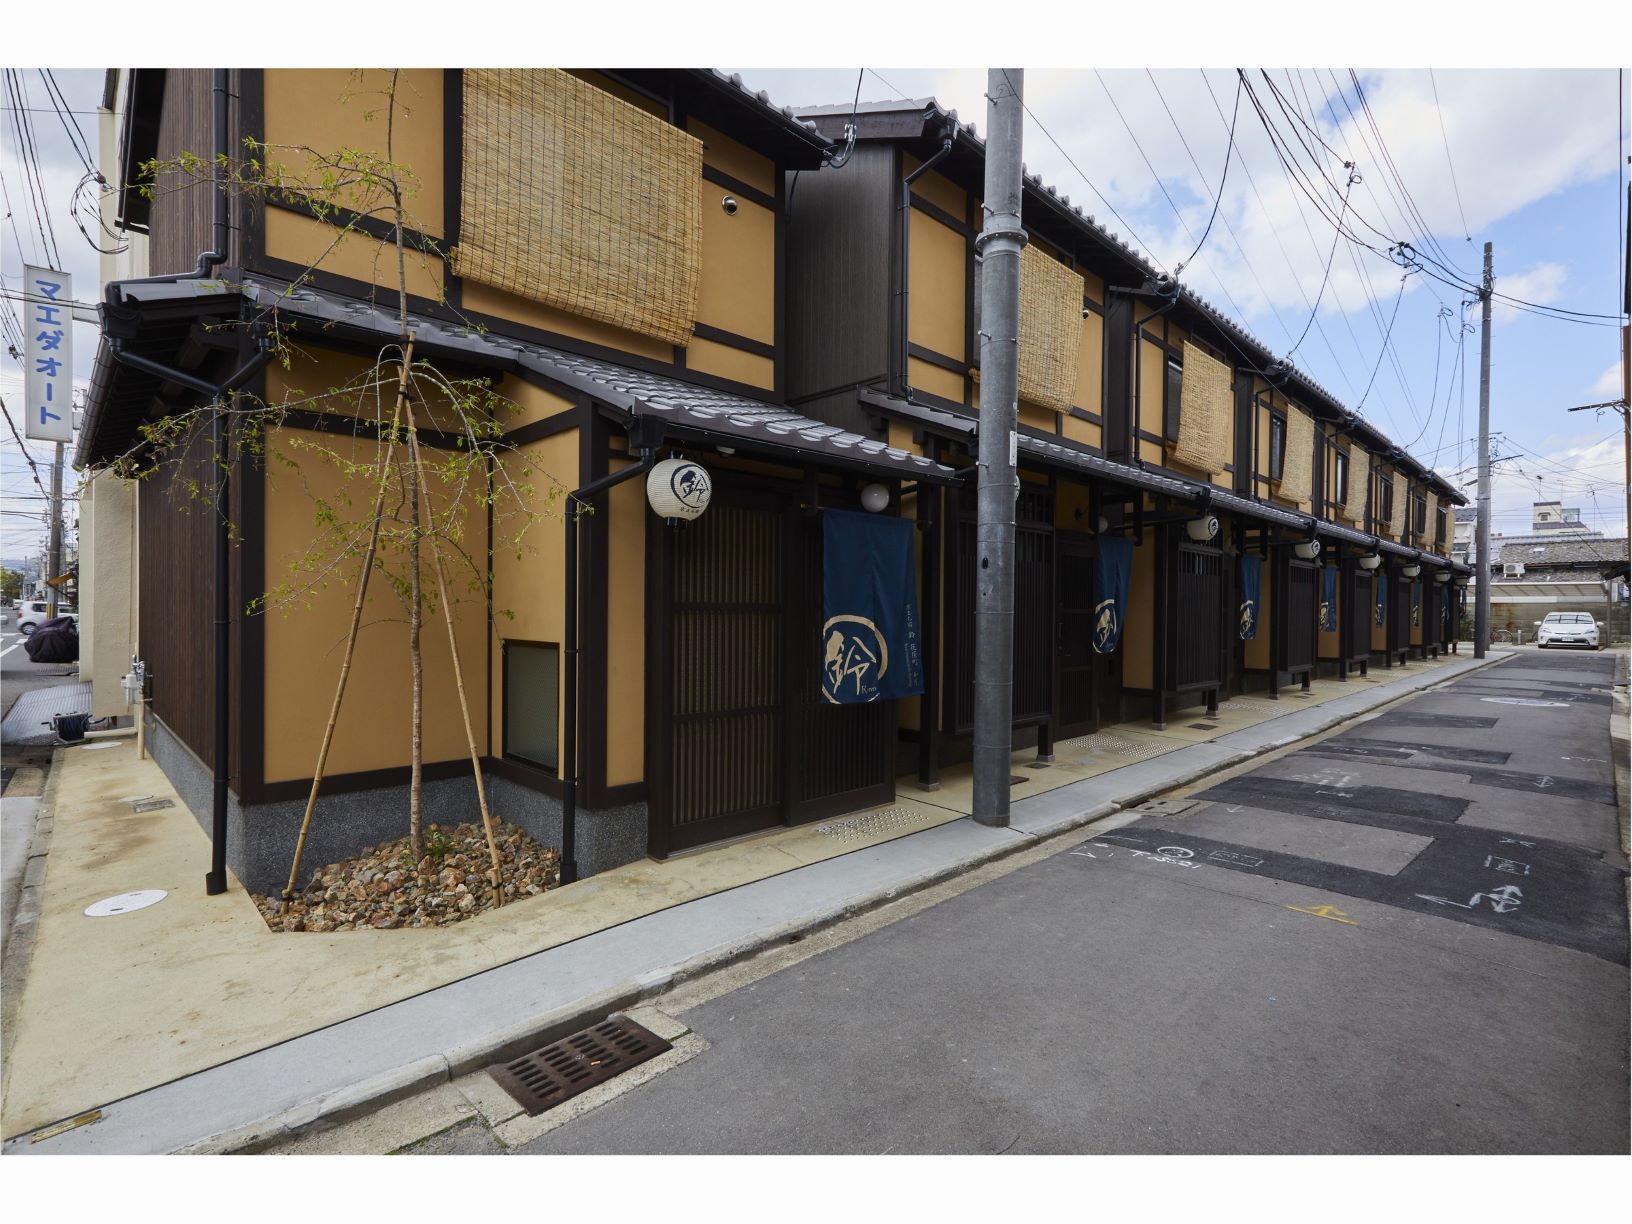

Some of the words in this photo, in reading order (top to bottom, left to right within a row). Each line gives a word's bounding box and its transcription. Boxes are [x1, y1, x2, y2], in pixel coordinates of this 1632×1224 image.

[35, 279, 64, 425] マエダオート
